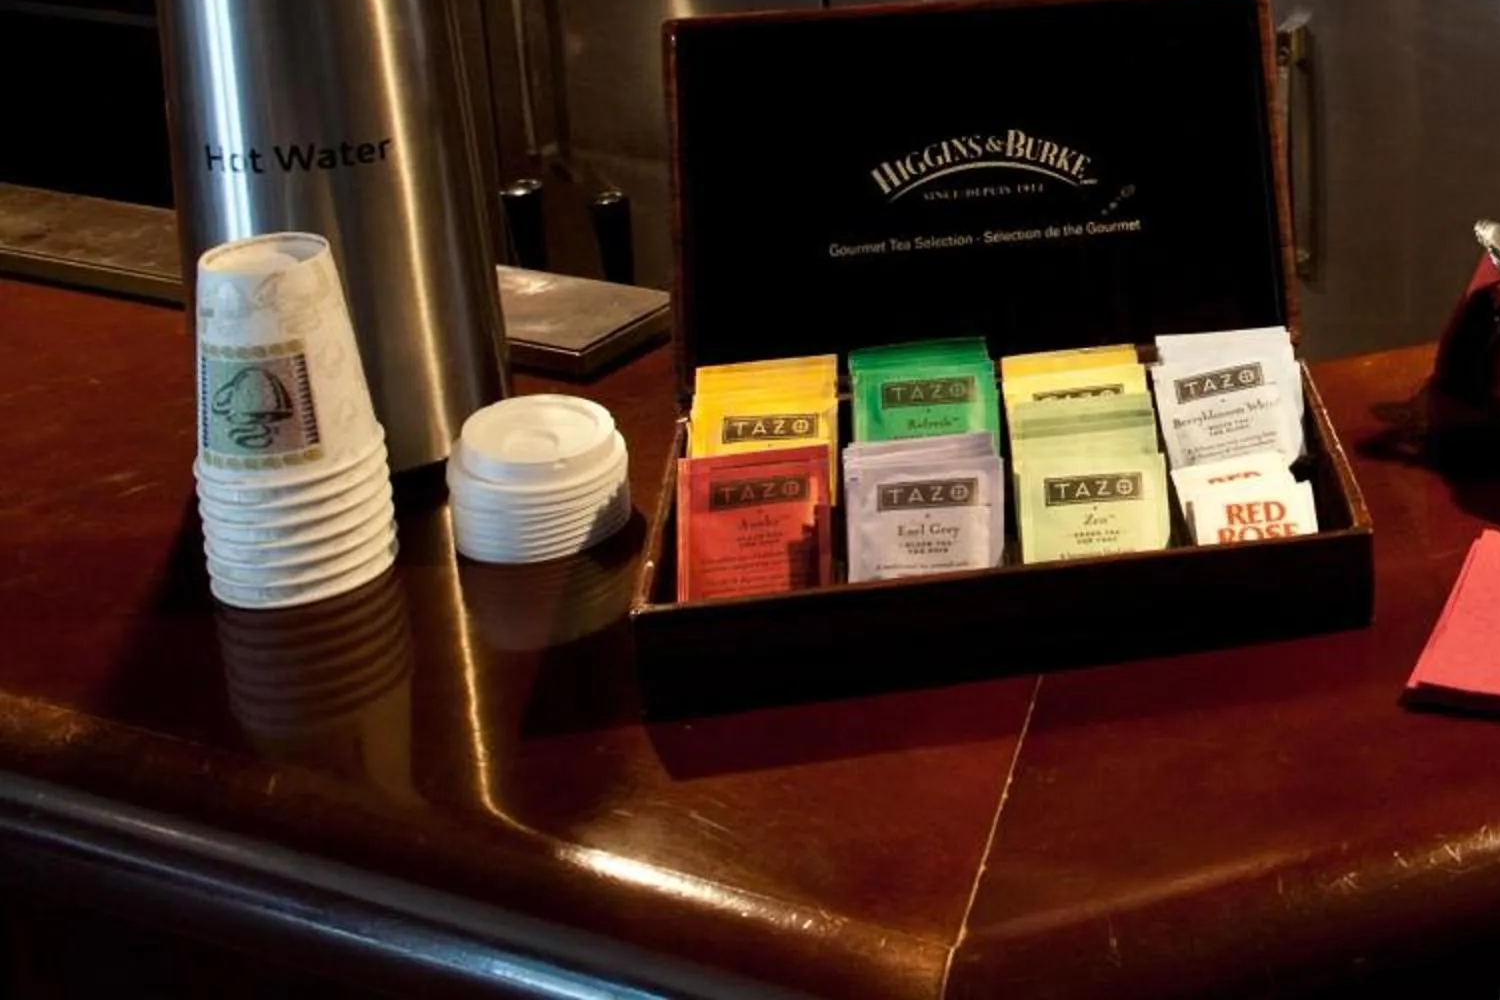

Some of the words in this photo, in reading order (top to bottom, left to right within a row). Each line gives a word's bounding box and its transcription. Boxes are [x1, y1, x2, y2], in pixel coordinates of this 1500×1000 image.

[204, 143, 265, 174] Hot
[273, 137, 392, 172] Water
[870, 134, 983, 195] HIGGINS
[985, 135, 1003, 153] &
[1005, 129, 1092, 180] BURKE
[829, 242, 886, 258] Gourmet
[890, 239, 911, 251] Tea
[914, 233, 974, 250] Selection
[1085, 219, 1142, 235] Gourmet
[890, 382, 966, 402] TAZO
[1183, 368, 1255, 396] TAZO
[731, 418, 810, 437] TAZO
[720, 480, 800, 502] TAZO
[888, 483, 969, 506] TAZO
[1054, 478, 1134, 499] TAZO
[1225, 501, 1287, 526] RED
[897, 523, 925, 537] Earl
[929, 522, 961, 539] Grey
[1217, 523, 1298, 545] ROSE
